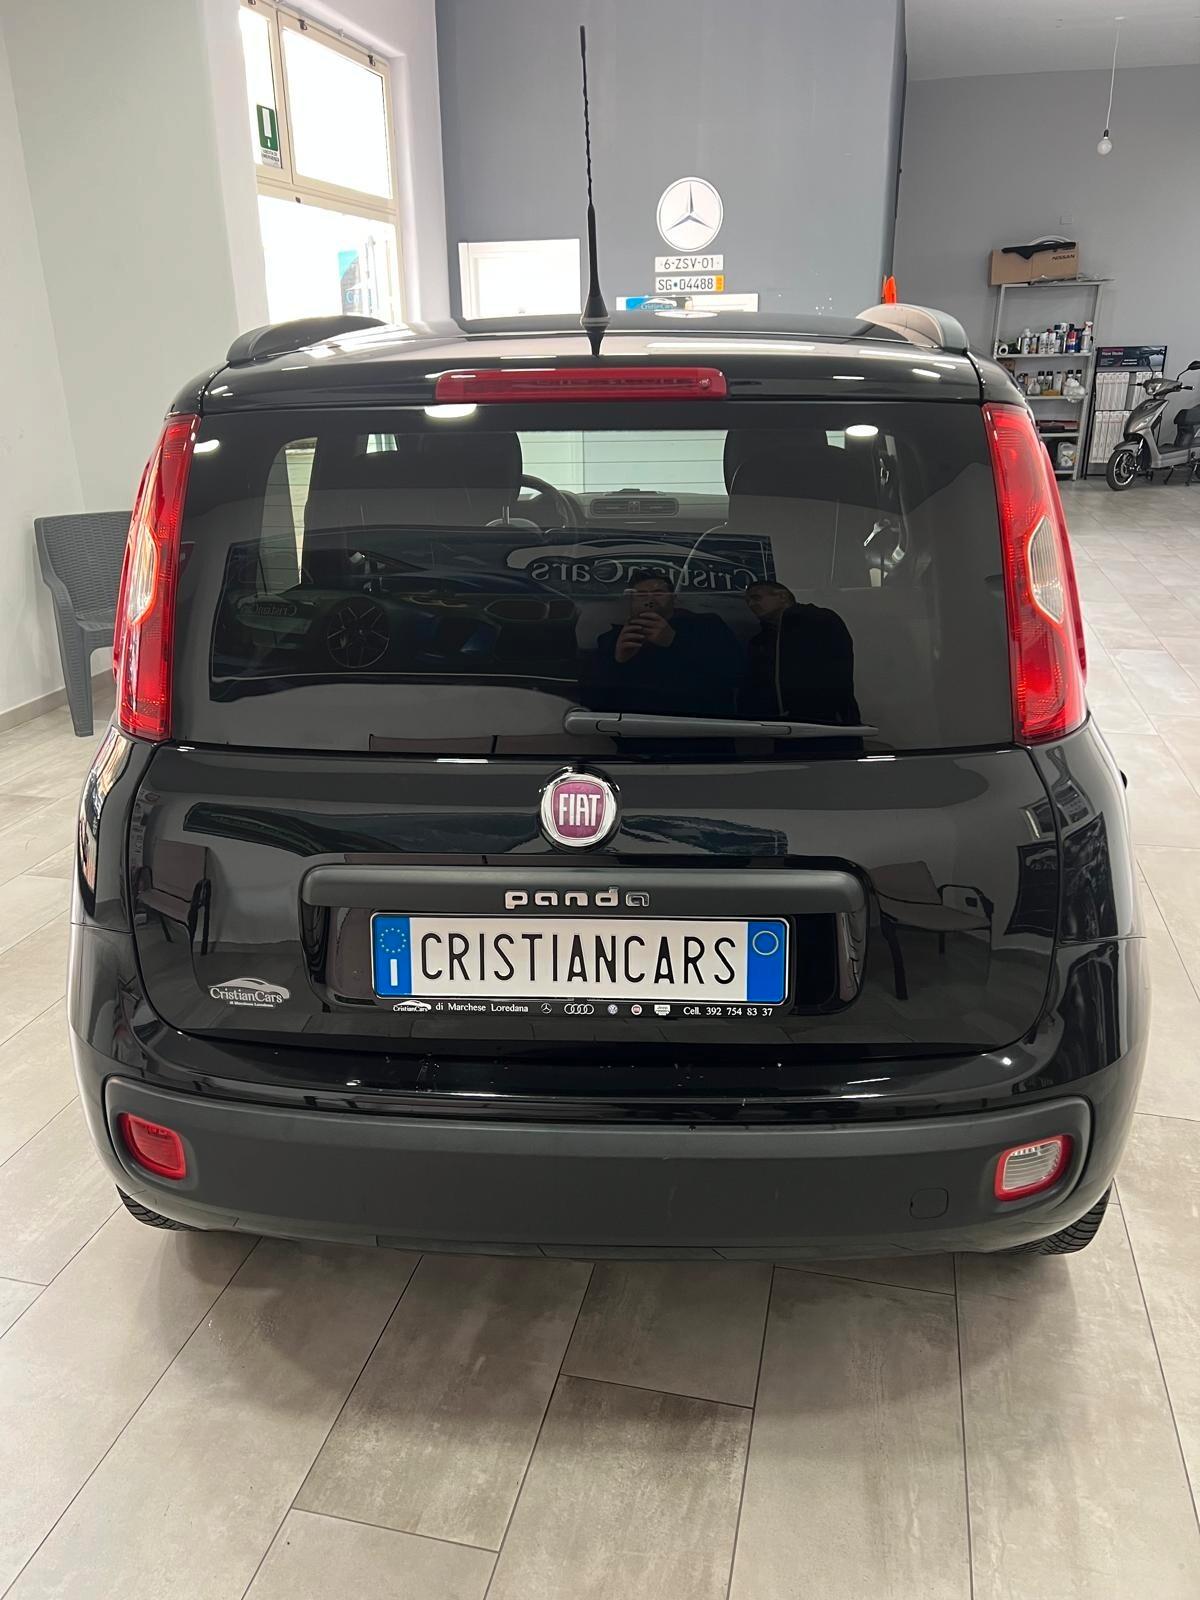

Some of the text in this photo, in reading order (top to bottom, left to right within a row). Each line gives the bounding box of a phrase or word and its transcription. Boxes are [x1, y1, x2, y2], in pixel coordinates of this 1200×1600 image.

[663, 257, 714, 270] 6-ZSV-01
[559, 793, 601, 827] FIAT
[505, 886, 650, 910] panda
[420, 932, 737, 985] CRISTIANCARS
[209, 987, 283, 1004] CristianCars
[435, 1002, 444, 1011] di
[447, 1002, 487, 1012] Marchese
[490, 1003, 529, 1013] Loredana
[683, 1006, 773, 1017] Cell. 392 754 83 37
